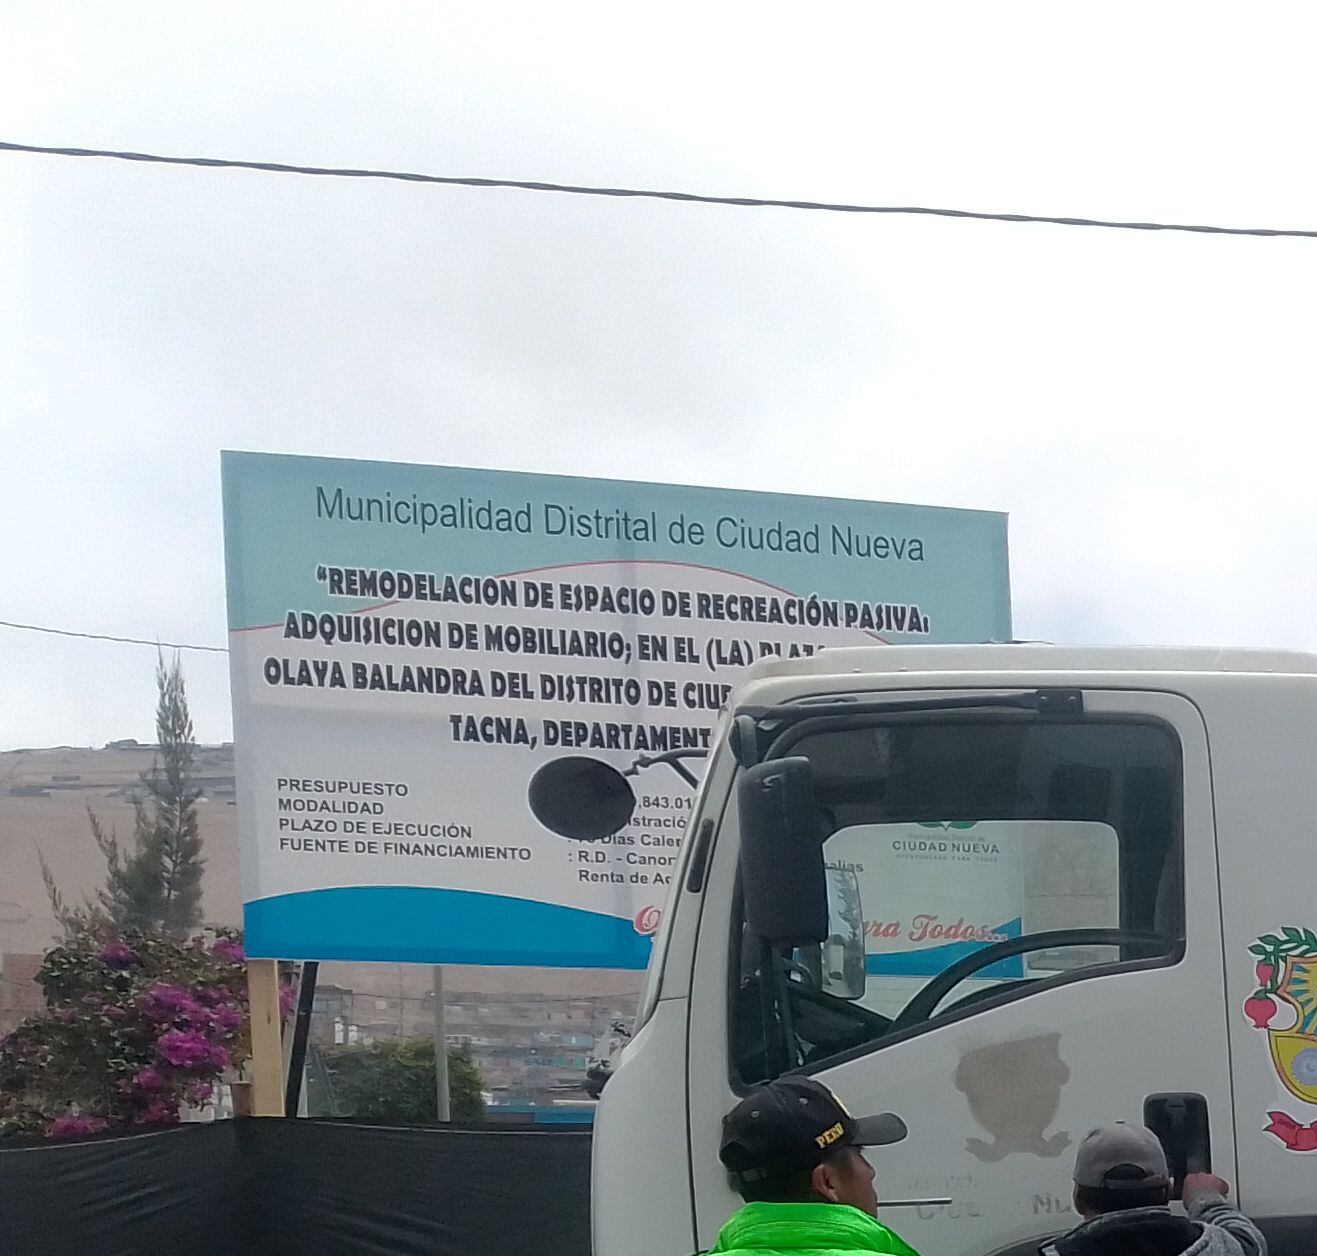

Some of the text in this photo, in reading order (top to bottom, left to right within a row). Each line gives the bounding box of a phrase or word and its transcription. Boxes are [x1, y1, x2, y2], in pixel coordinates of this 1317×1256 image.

[316, 486, 925, 562] Municipalidad Distrital de Ciudad Nueva
[523, 581, 554, 609] DE
[560, 584, 656, 616] ESPACIO
[661, 590, 692, 618] DE
[697, 592, 838, 628] RECREACIÓN
[844, 602, 930, 634] PASIVA:
[284, 611, 441, 648] ADQUISICION
[448, 622, 478, 650] DE
[485, 625, 633, 666] MOBILIARIO;
[637, 634, 668, 662] EN
[674, 637, 700, 664] EL
[706, 638, 754, 671] (LA)
[264, 657, 347, 688] OLAYA
[352, 662, 485, 697] BALANDRA
[491, 671, 534, 700] DEL
[540, 674, 641, 707] DISTRITO
[647, 680, 678, 708] DE
[449, 714, 538, 750] TACNA,
[277, 778, 409, 797] PRESUPUESTO
[278, 798, 384, 815] MODALIDAD
[278, 818, 338, 833] PLAZO
[343, 822, 368, 835] DE
[372, 824, 473, 839] EJECUCIÓN
[279, 838, 349, 854] FUENTE
[355, 841, 379, 855] DE
[383, 842, 532, 861] FINANCIAMIENTO
[892, 840, 1000, 855] CIUDAD NUEVA
[578, 869, 625, 884] Renta
[629, 872, 650, 885] de
